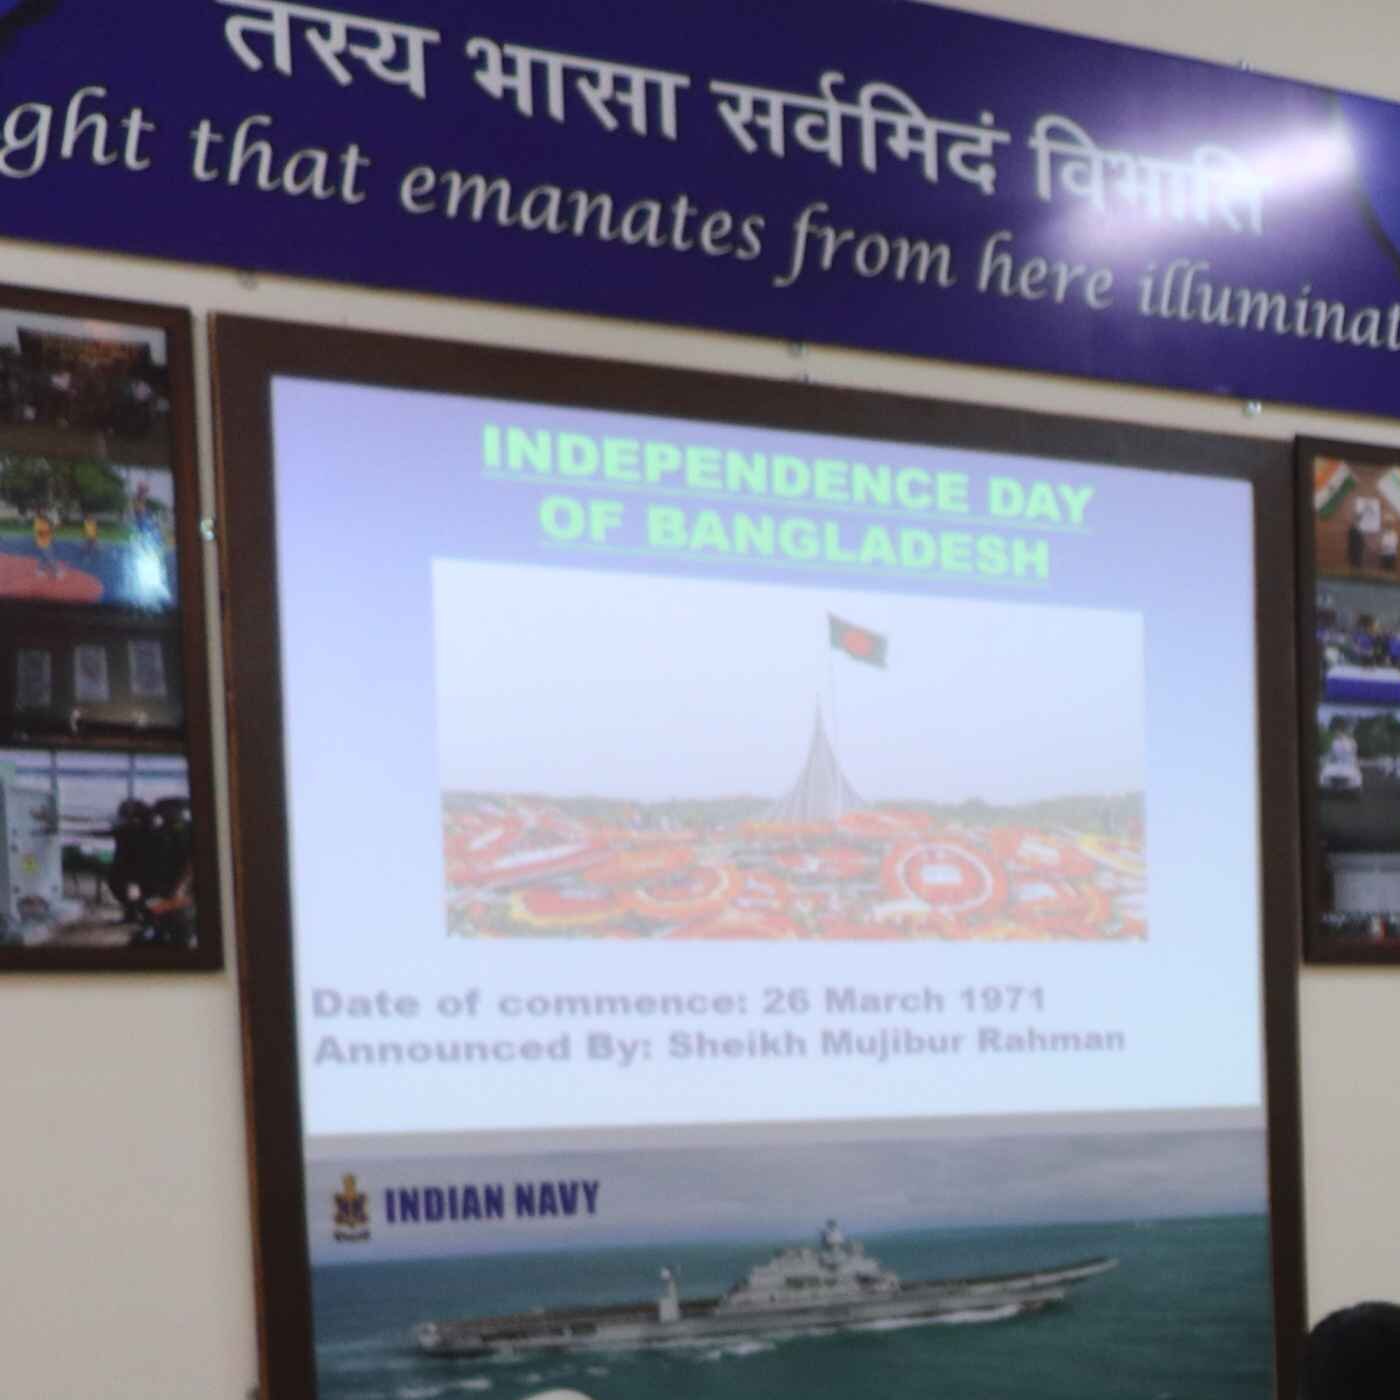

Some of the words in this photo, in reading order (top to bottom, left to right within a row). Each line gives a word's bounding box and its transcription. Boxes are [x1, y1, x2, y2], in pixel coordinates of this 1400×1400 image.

[216, 0, 441, 99] तस्य
[465, 35, 690, 141] भासा
[709, 70, 1011, 194] सर्वमिदं
[0, 85, 155, 178] ght
[190, 115, 370, 205] that
[400, 164, 766, 260] emanates
[774, 202, 956, 288] from
[977, 232, 1114, 312] here
[481, 423, 971, 513] INDEPENDENCE
[988, 477, 1095, 528] DAY
[537, 495, 624, 544] OF
[646, 503, 1051, 580] BANGLADESH
[312, 988, 420, 1019] Date
[436, 990, 481, 1017] of
[498, 991, 748, 1018] commence:
[761, 987, 812, 1015] 26
[825, 985, 946, 1014] March
[959, 985, 1046, 1012] 1971
[313, 1032, 572, 1065] Announced
[584, 1030, 653, 1066] By:
[666, 1028, 808, 1061] Sheikh
[819, 1025, 965, 1063] Mujibur
[976, 1025, 1126, 1055] Rahman
[384, 1183, 505, 1223] INDIAN
[514, 1179, 600, 1217] NAVY
